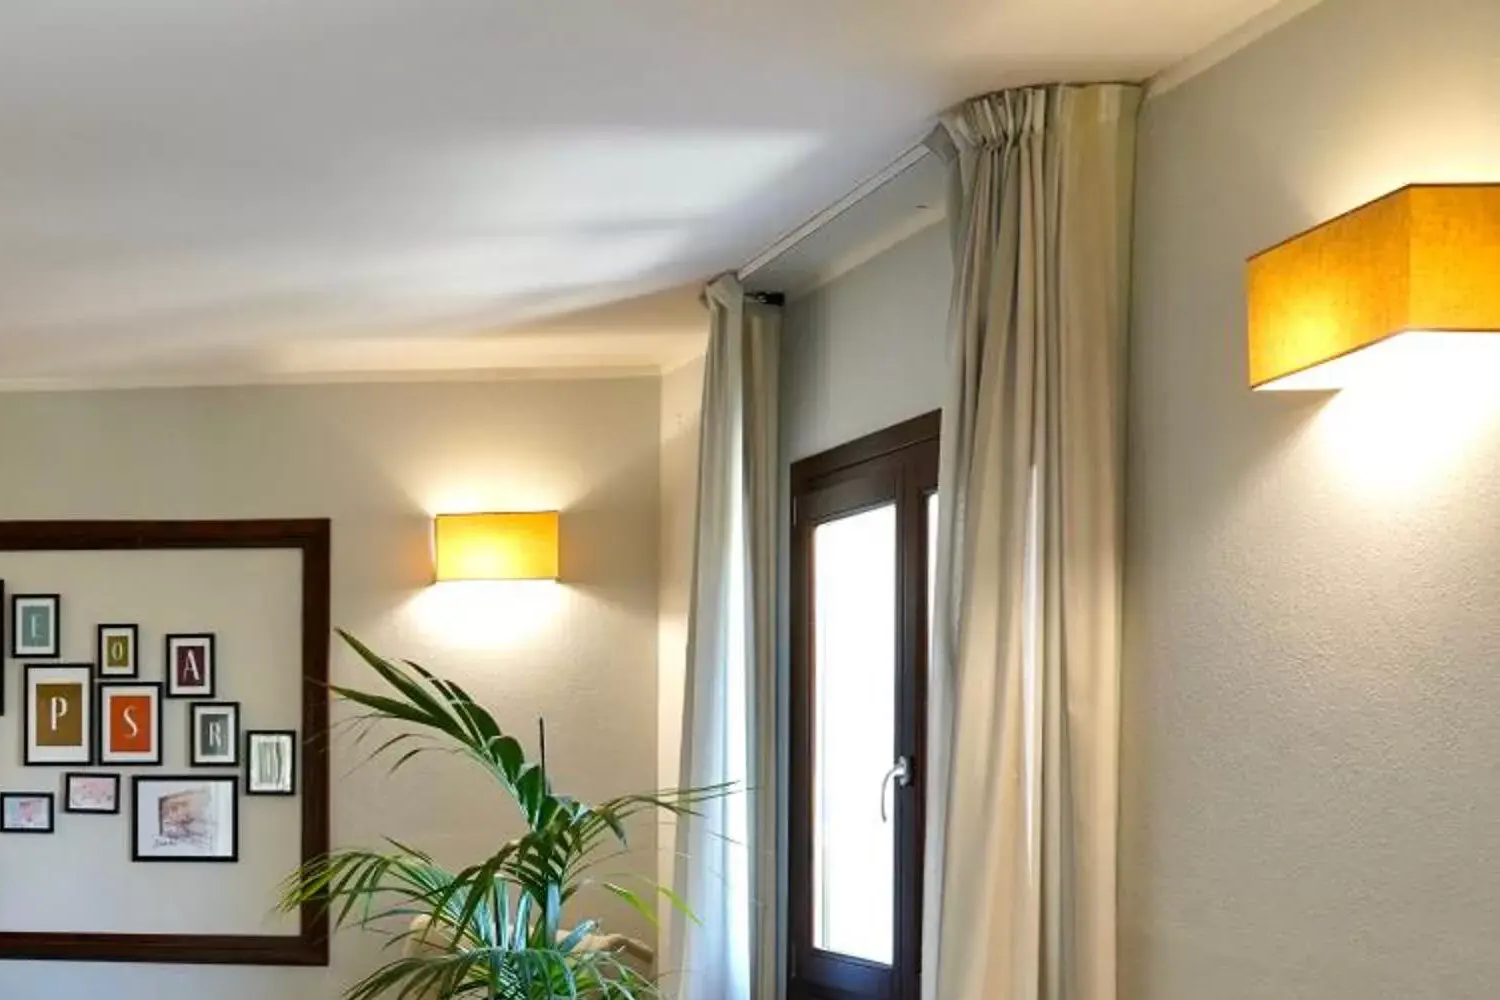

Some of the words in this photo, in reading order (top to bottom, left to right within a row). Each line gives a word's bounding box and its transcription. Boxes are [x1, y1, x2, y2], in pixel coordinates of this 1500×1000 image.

[111, 640, 123, 661] O
[183, 648, 200, 681] A
[51, 696, 68, 731] P
[122, 705, 139, 740] S
[208, 721, 223, 747] R
